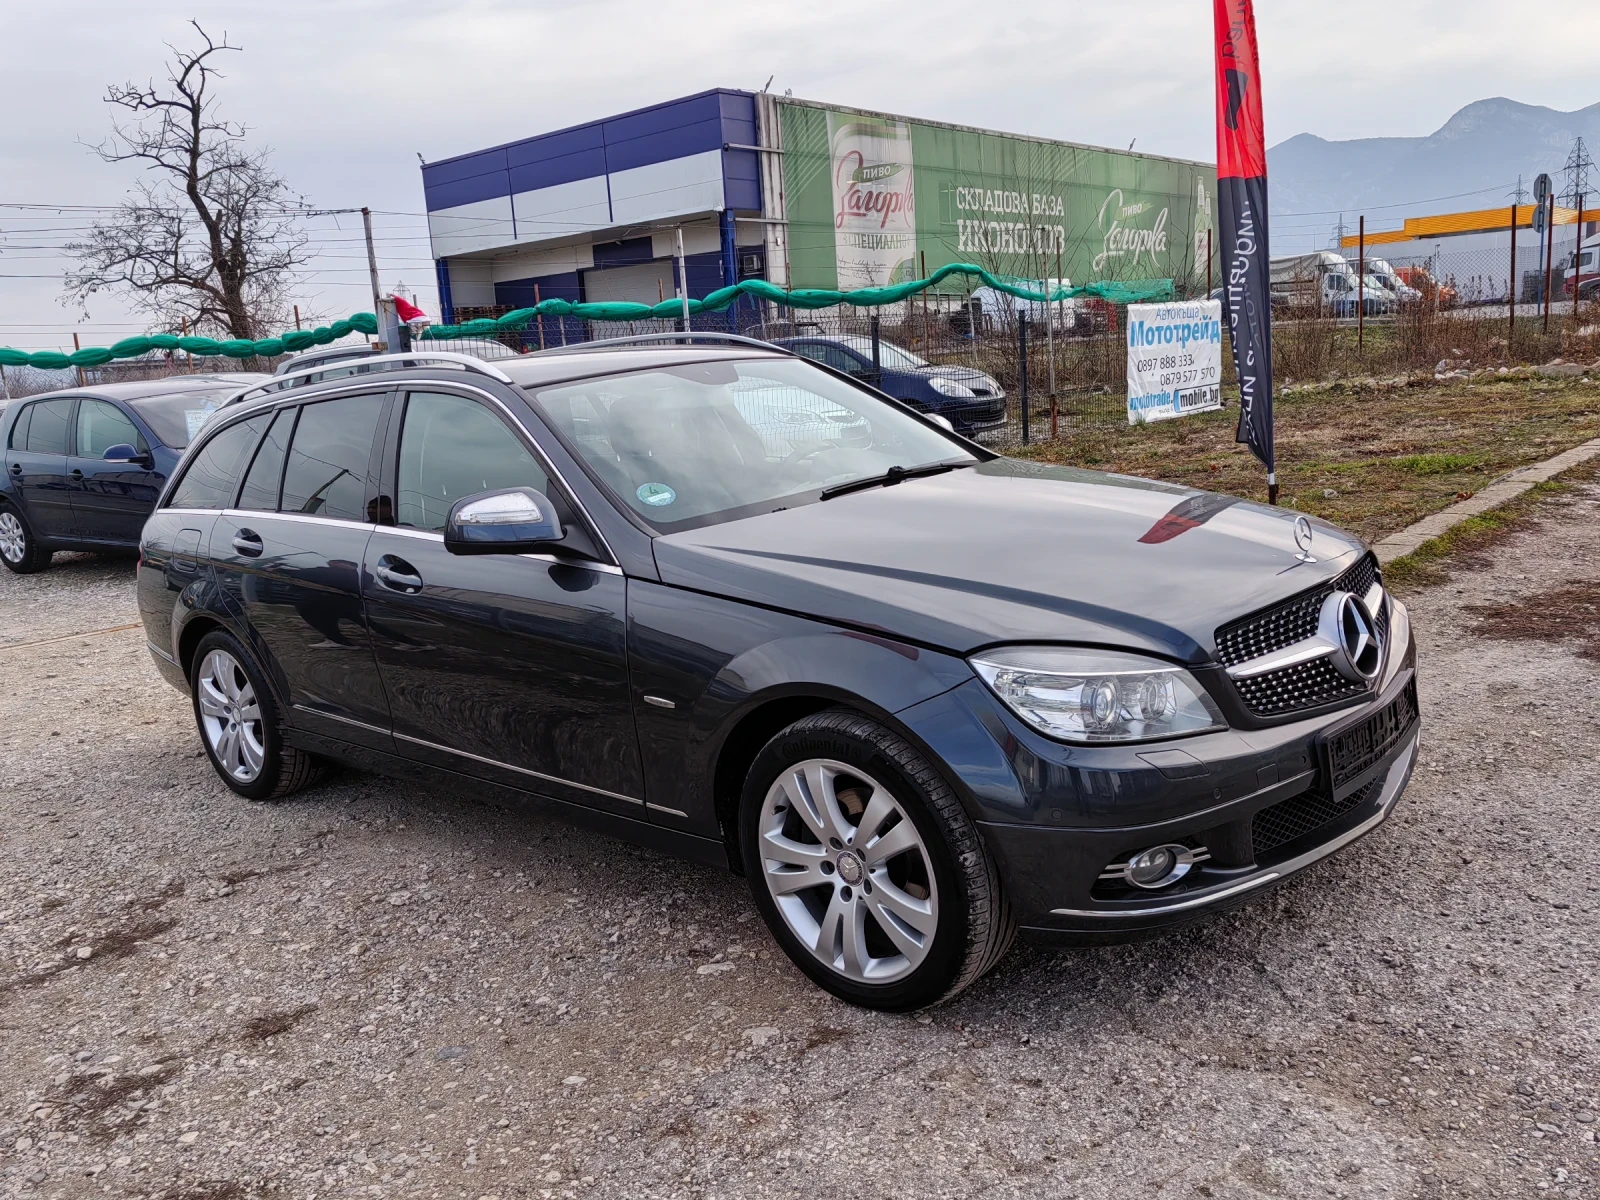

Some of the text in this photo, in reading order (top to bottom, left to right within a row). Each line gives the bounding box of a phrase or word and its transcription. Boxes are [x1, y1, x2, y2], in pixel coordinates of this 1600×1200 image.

[956, 186, 1065, 216] СКЛАДОВА БАЗА
[1130, 315, 1220, 349] Мототрейд
[1137, 358, 1158, 373] 0897
[1159, 356, 1176, 370] 888
[1160, 366, 1216, 386] 0879 577 570
